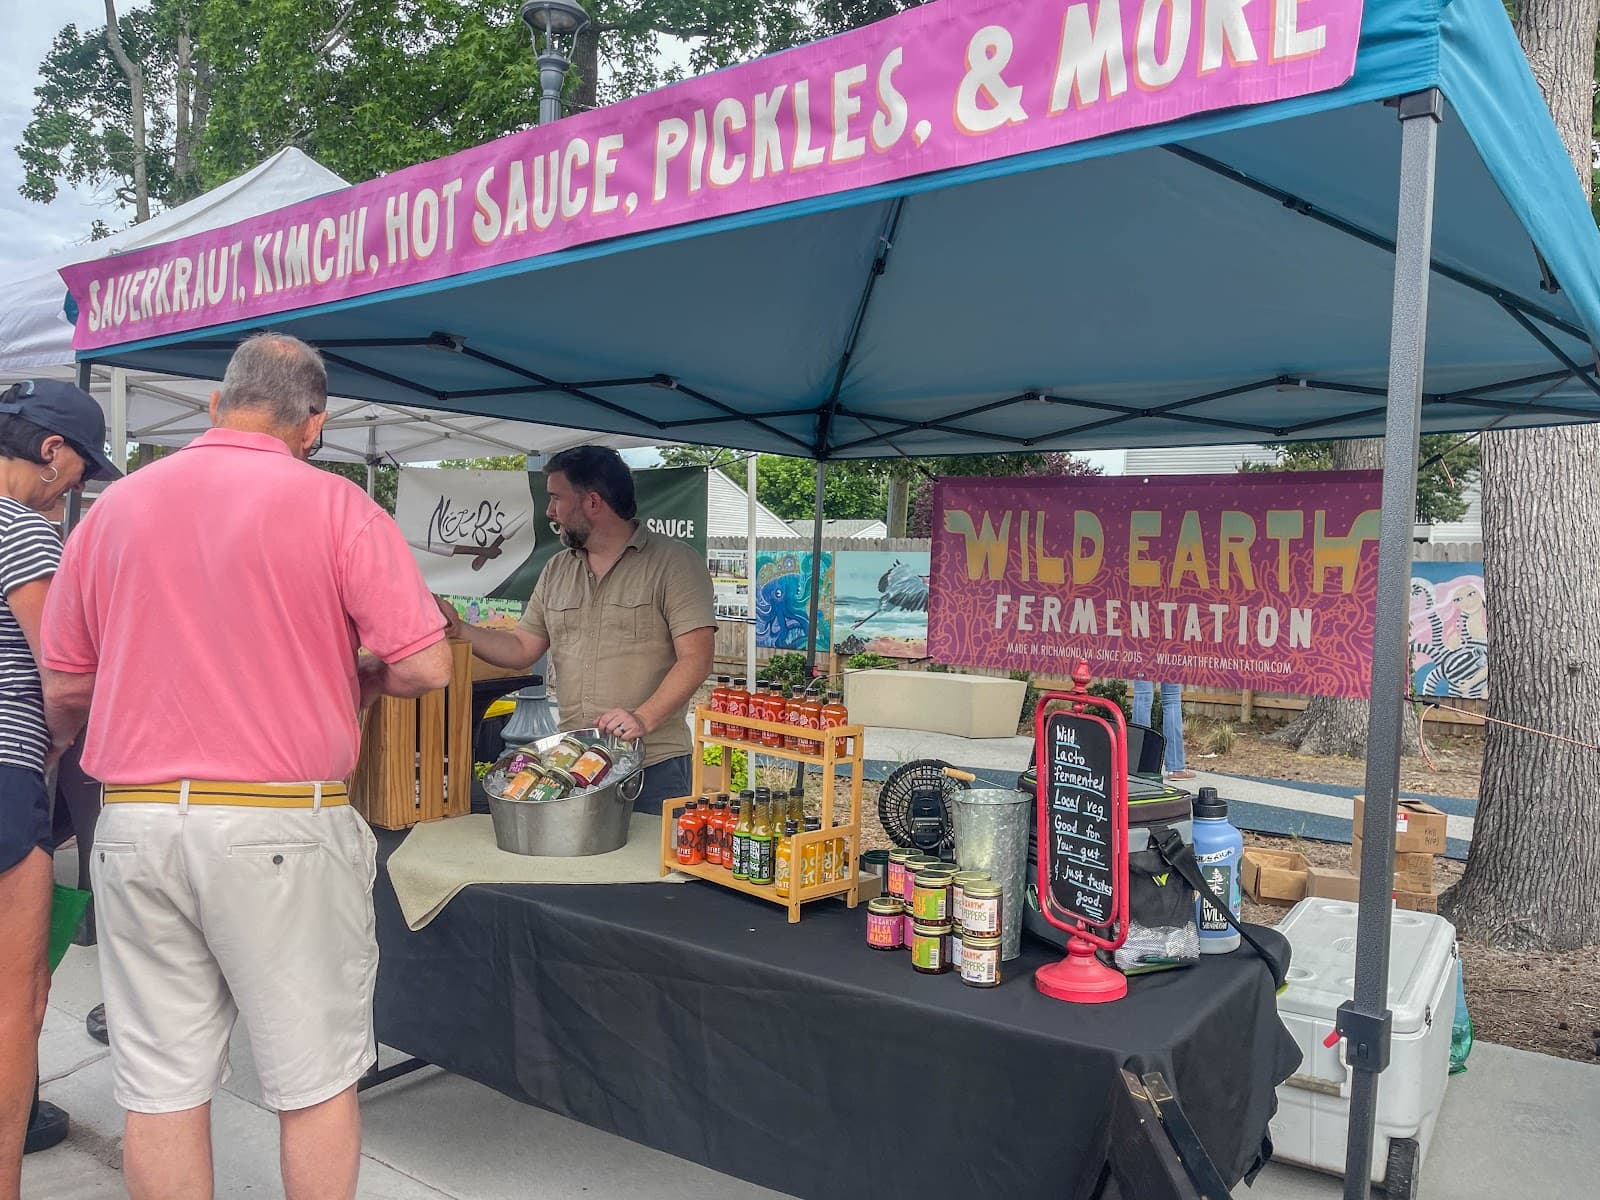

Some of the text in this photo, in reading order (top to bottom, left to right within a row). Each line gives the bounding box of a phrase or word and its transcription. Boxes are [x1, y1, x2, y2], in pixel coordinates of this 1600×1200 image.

[88, 240, 246, 332] SAUERKRAUT,
[254, 206, 379, 296] KIMCHI,
[385, 176, 463, 265] HOT
[472, 132, 639, 246] SAUCE,
[652, 46, 931, 202] PICKLES,
[954, 25, 1029, 134] &
[646, 517, 695, 539] SAUCE
[943, 508, 1382, 594] WILD EARTH
[995, 594, 1313, 649] FERMENTATION
[1007, 643, 1028, 655] MADE
[1029, 645, 1039, 655] IN
[1096, 649, 1120, 662] SINCE
[1122, 651, 1143, 664] 2015
[1156, 653, 1292, 674] WILDEARTHFERMENTATION.COM
[1056, 724, 1075, 744] Wild
[1055, 744, 1086, 766] Lacto
[1053, 765, 1105, 791] fermented
[1054, 788, 1104, 823] Local veg
[1055, 814, 1101, 840] Good for
[1056, 834, 1073, 850] Your
[1087, 873, 1113, 894] tastes
